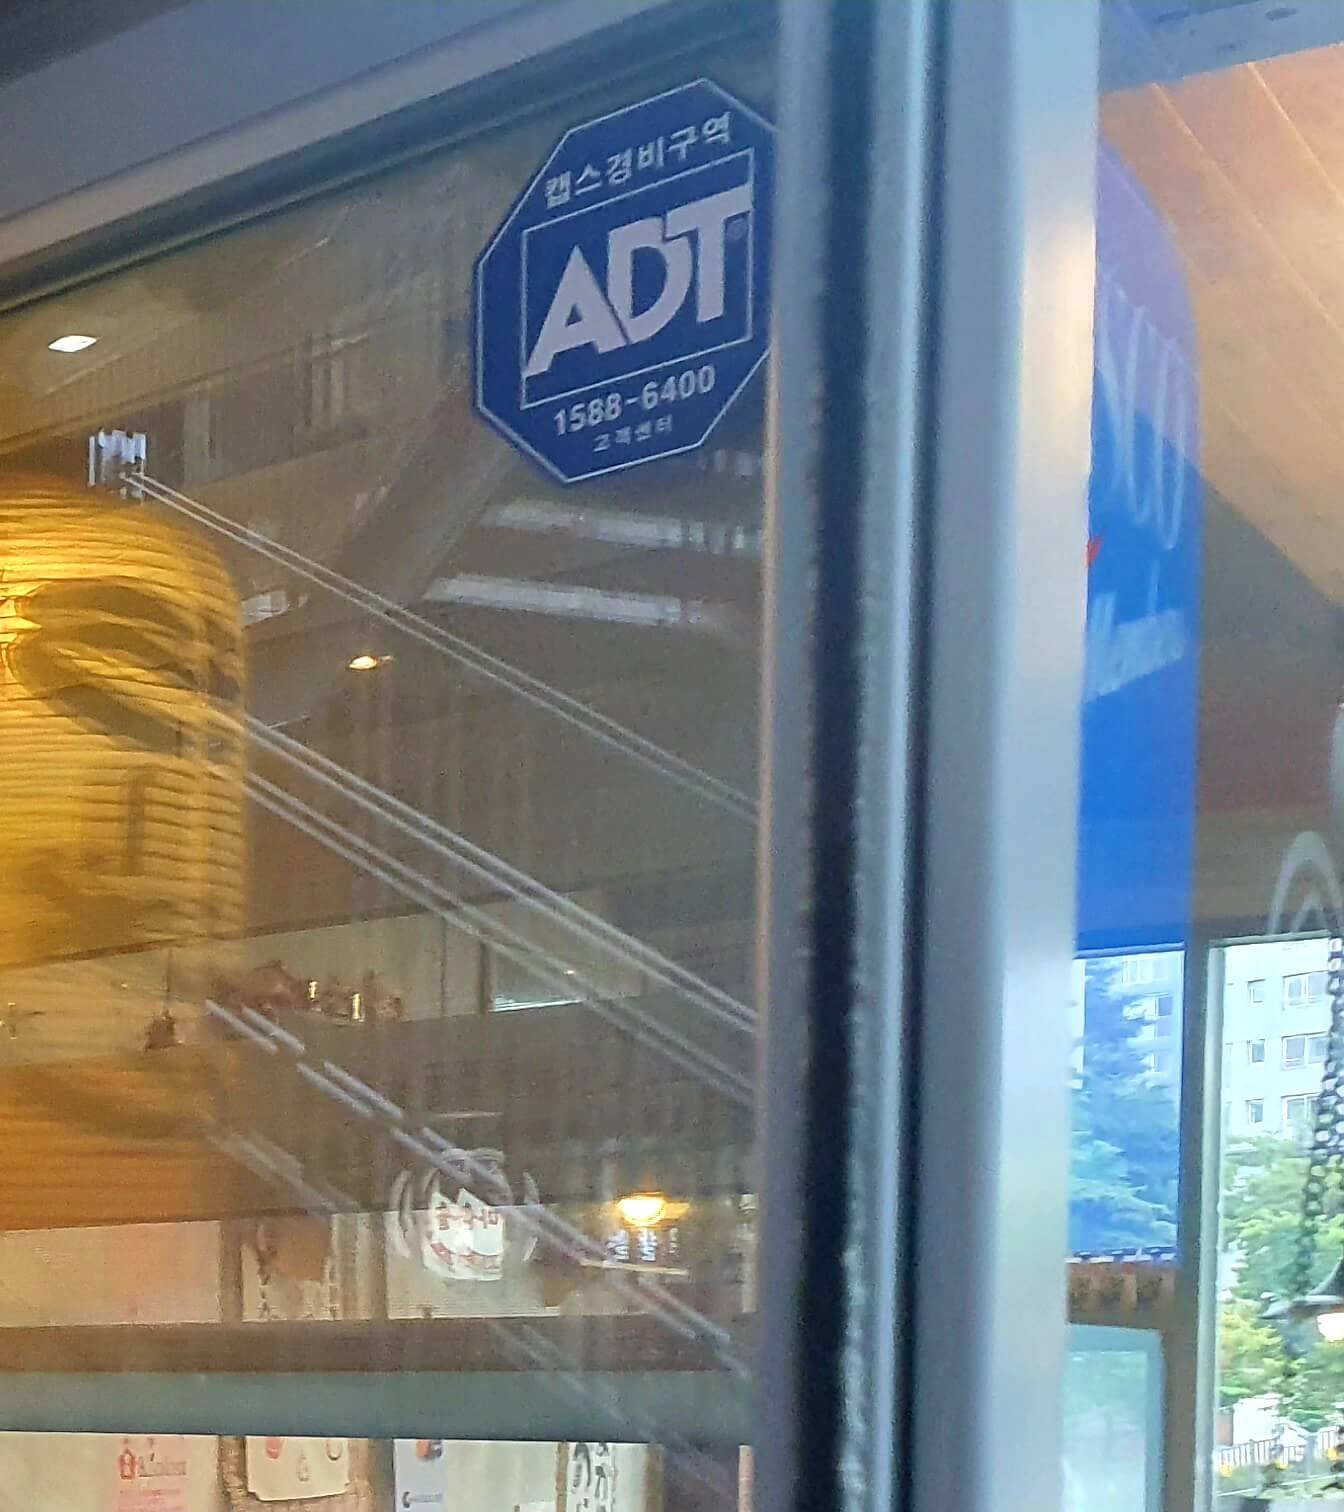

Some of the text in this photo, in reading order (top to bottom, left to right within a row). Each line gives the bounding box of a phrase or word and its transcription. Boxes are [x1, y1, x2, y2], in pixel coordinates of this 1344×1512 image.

[544, 111, 733, 208] 캡스경비구역
[523, 183, 754, 378] ADT
[554, 363, 718, 437] 1588-6400
[592, 415, 674, 453] 고객센터
